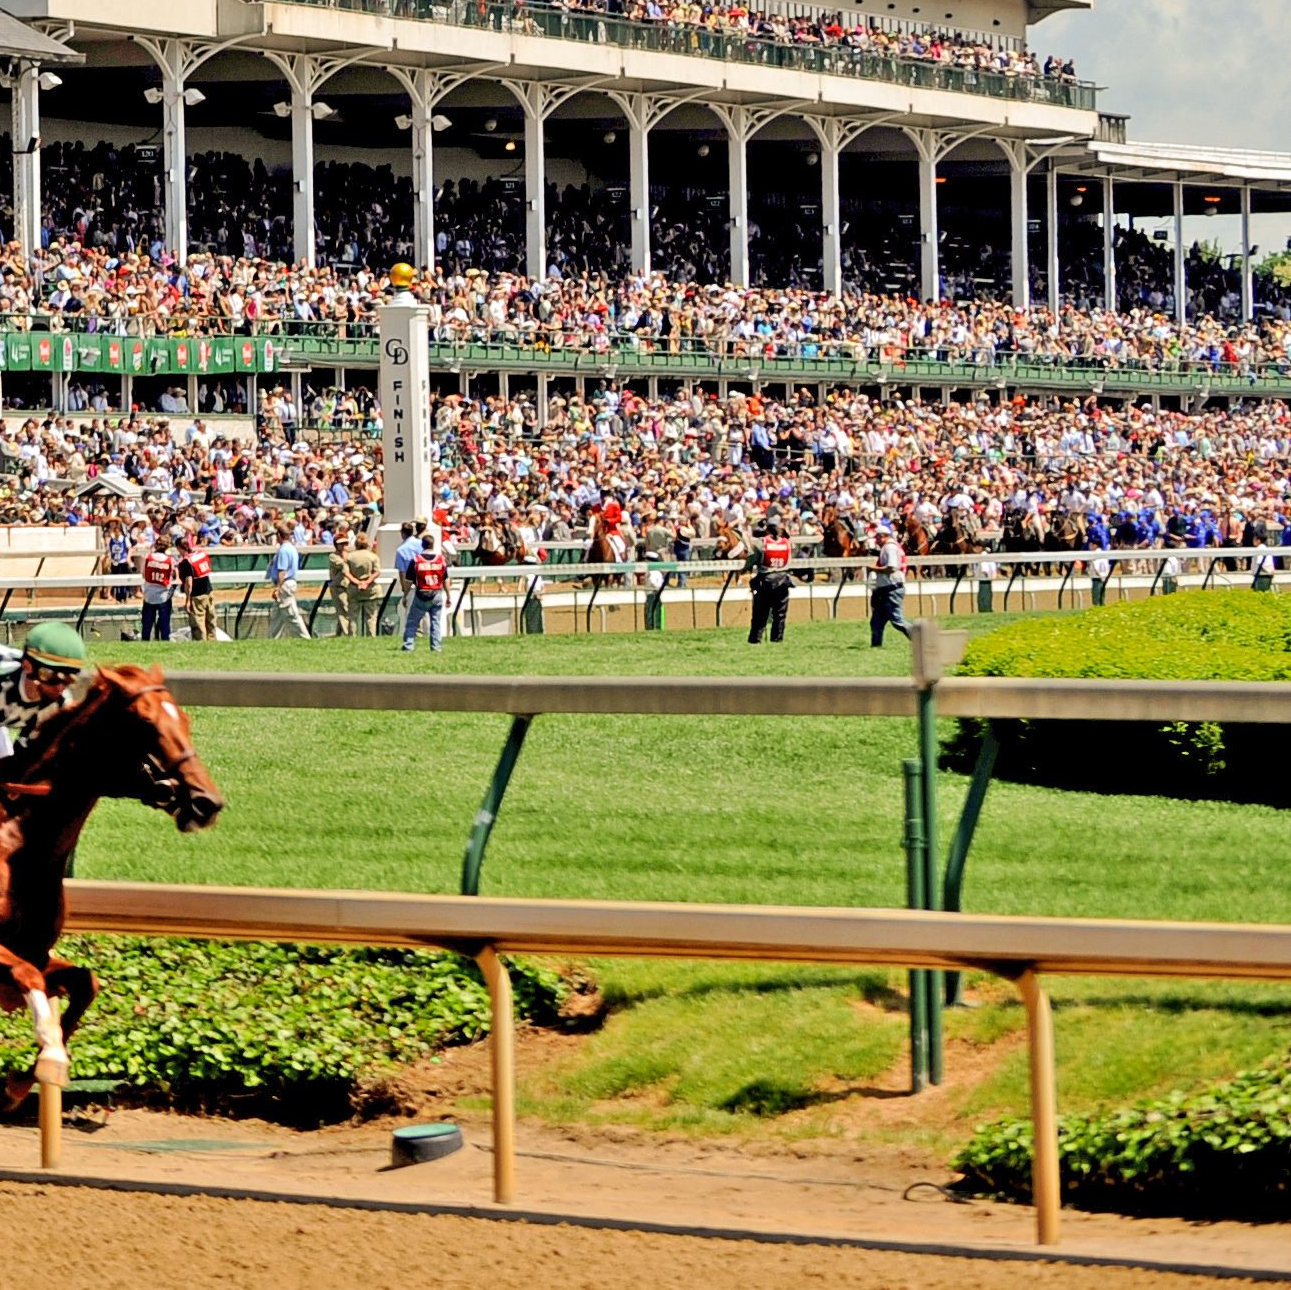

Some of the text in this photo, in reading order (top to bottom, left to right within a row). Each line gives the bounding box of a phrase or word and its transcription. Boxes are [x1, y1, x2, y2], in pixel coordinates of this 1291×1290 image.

[385, 338, 409, 365] CD
[393, 380, 405, 463] FINISH
[421, 380, 429, 463] FINISH
